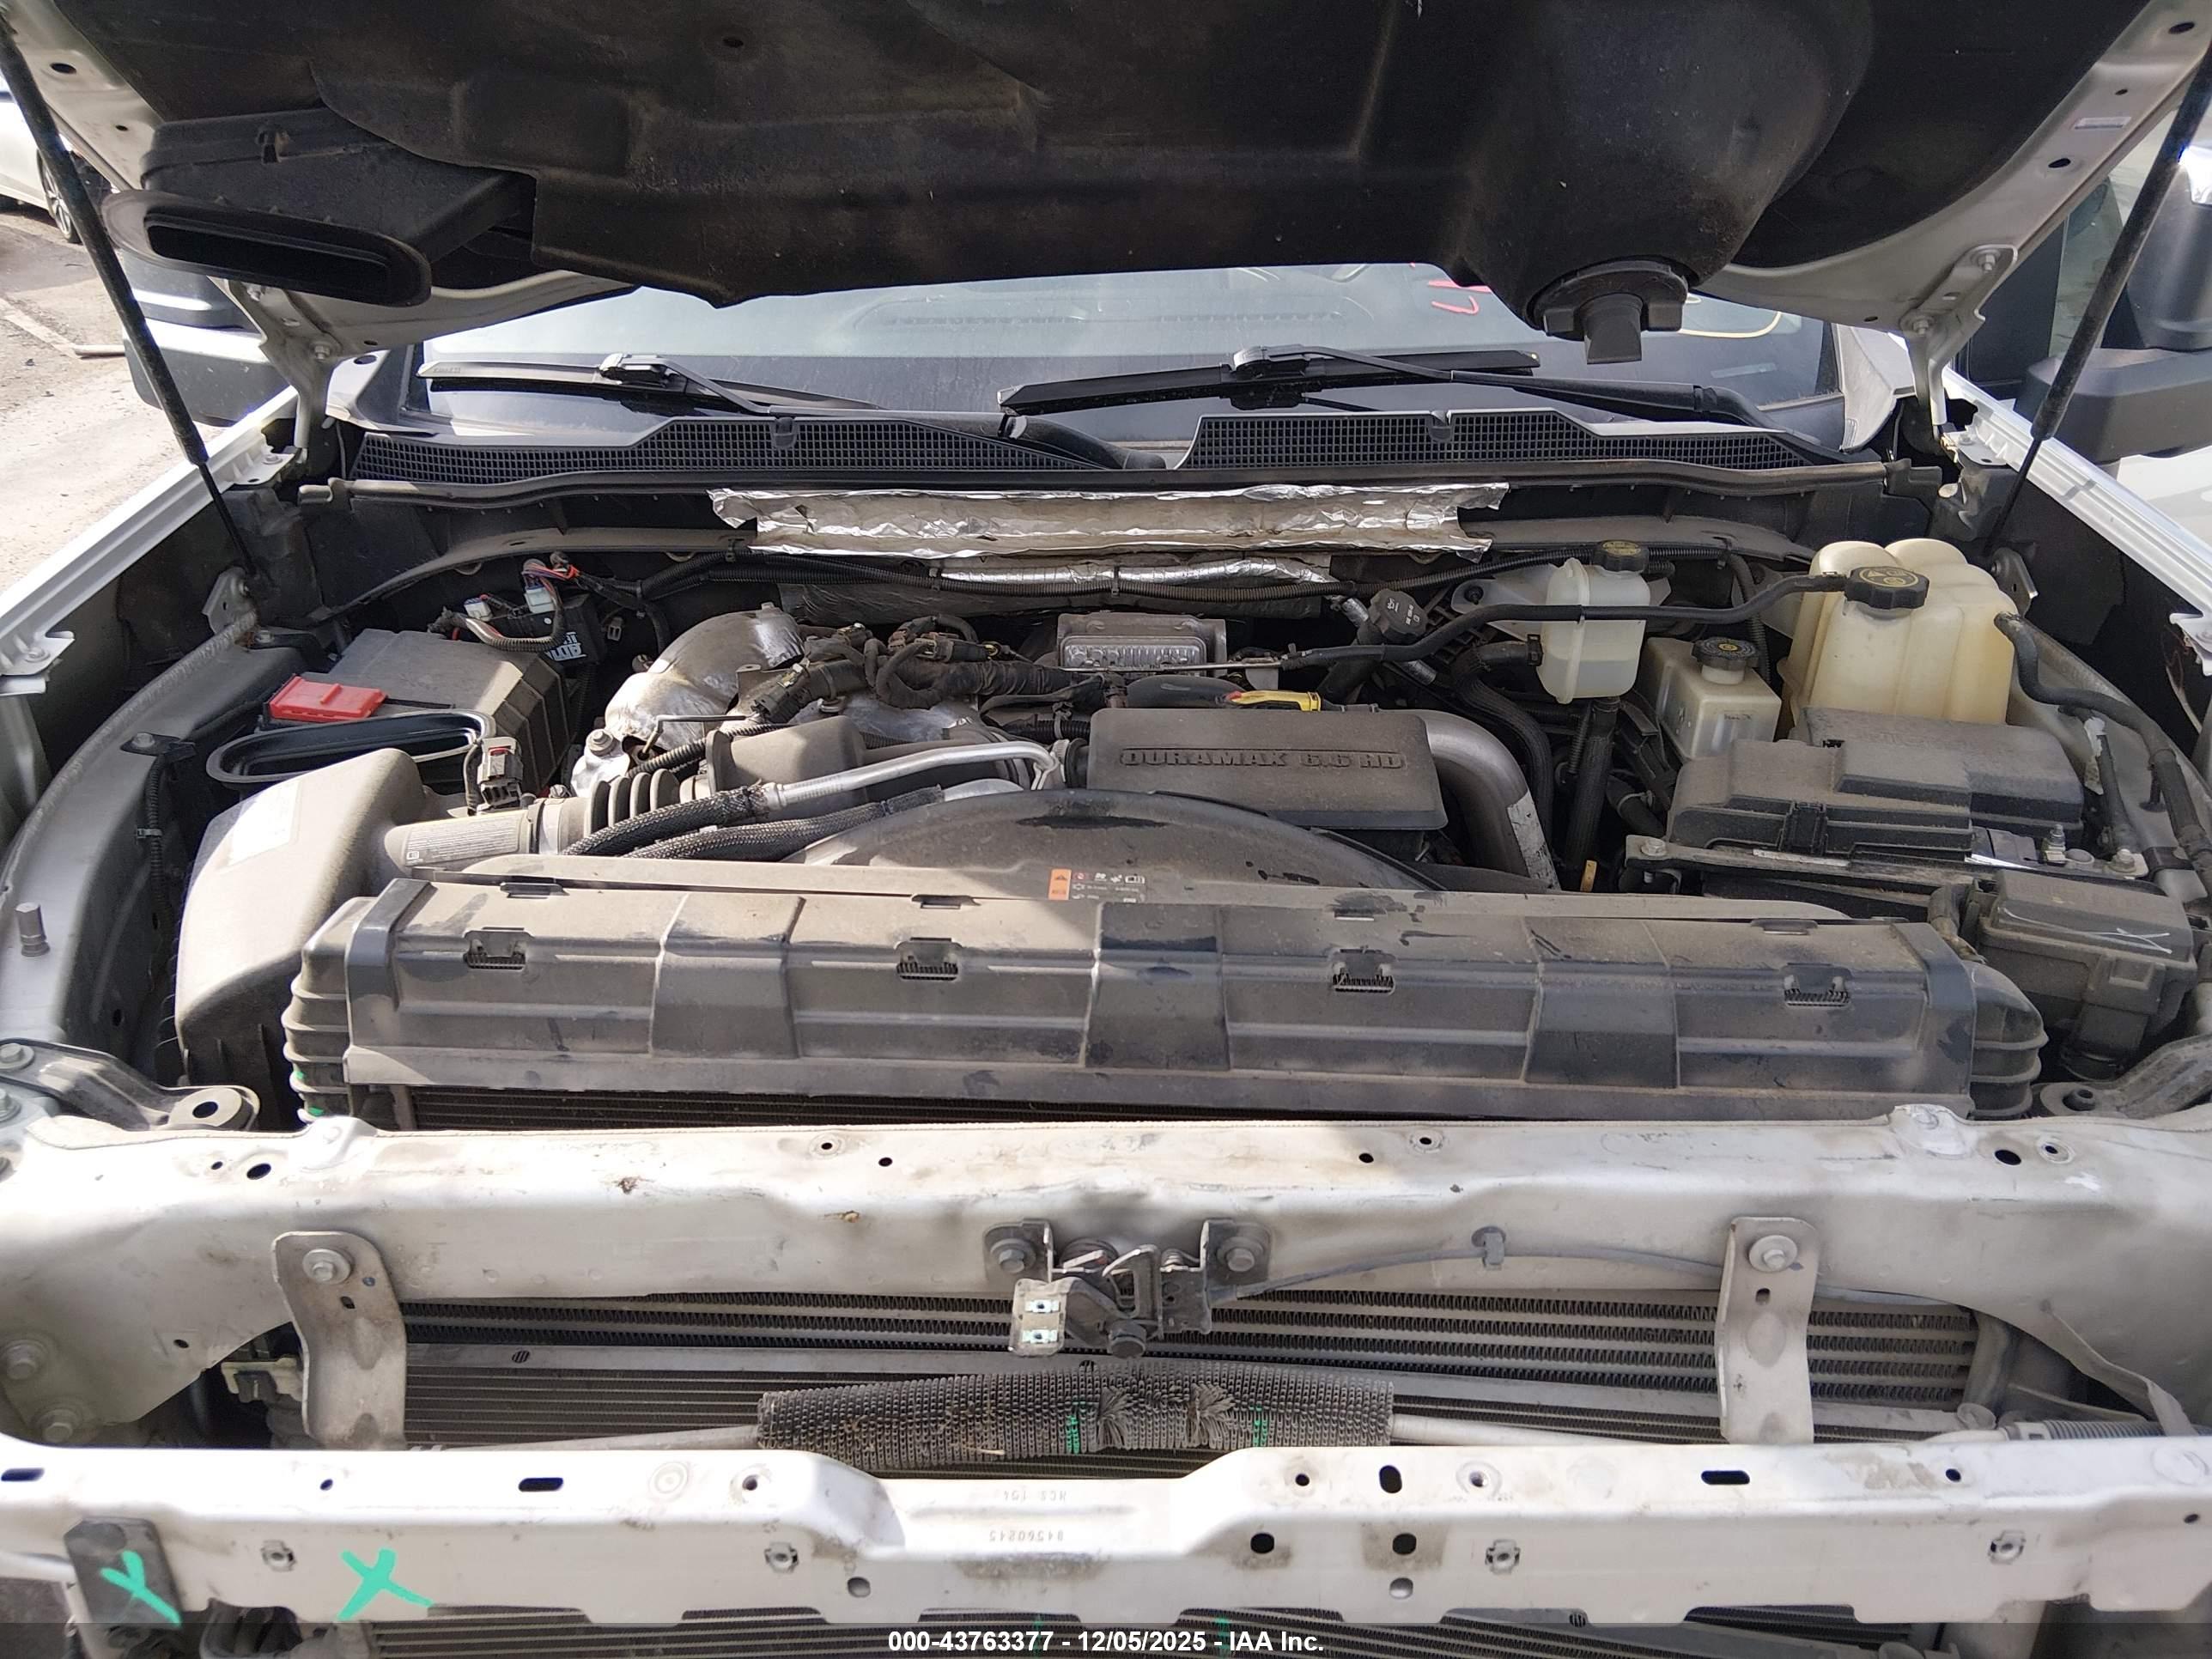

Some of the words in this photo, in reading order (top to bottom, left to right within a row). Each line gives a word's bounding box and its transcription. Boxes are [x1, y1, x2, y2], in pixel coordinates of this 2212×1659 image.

[1120, 750, 1288, 767] DURAMAX
[1299, 753, 1352, 768] 6.6
[1359, 753, 1407, 770] HD
